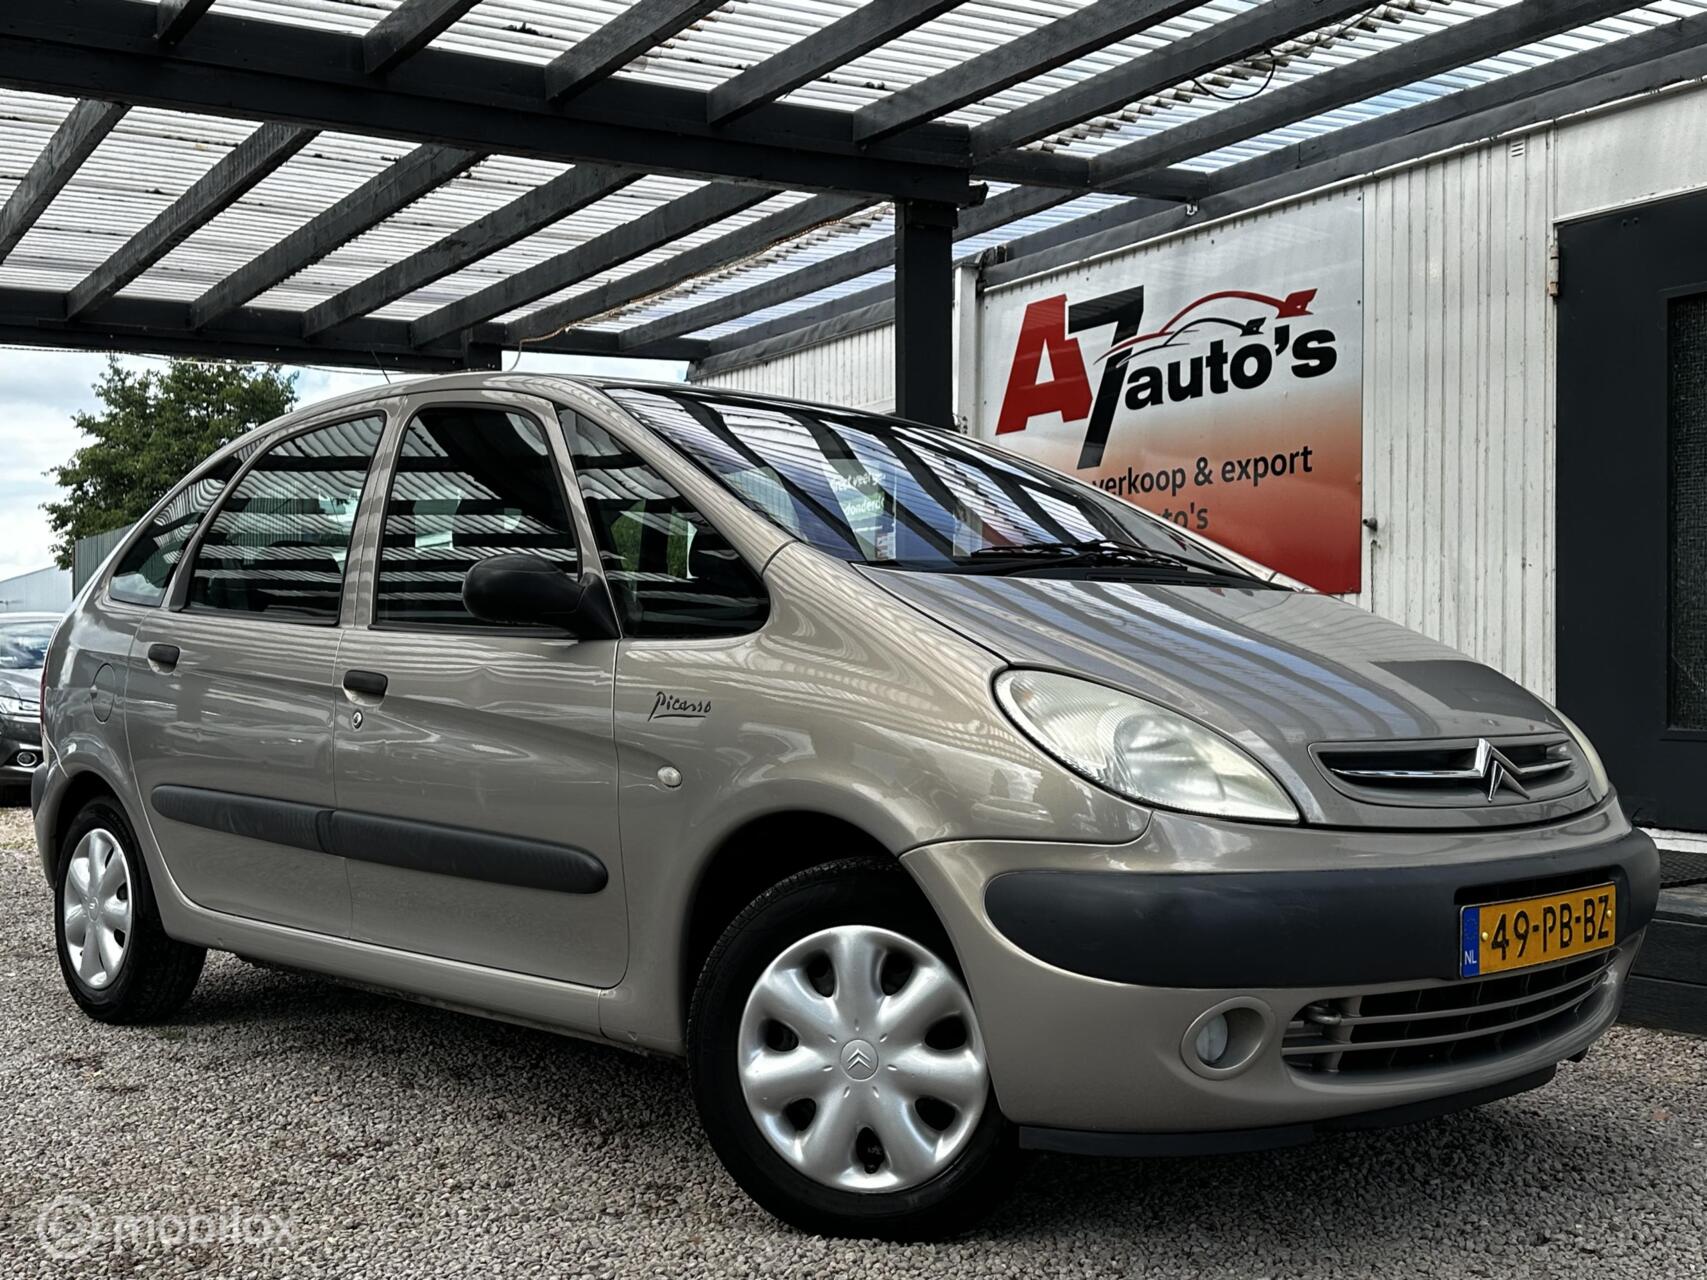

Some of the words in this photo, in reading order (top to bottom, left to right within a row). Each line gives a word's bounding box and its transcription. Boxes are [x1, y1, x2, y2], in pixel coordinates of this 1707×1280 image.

[996, 285, 1144, 470] A7
[1124, 324, 1338, 411] auto's
[1194, 457, 1214, 486] &
[1221, 445, 1313, 487] export
[1158, 502, 1209, 530] to's
[647, 691, 711, 722] Picasso
[1491, 895, 1609, 961] 49-PB-BZ
[1464, 951, 1477, 965] NL
